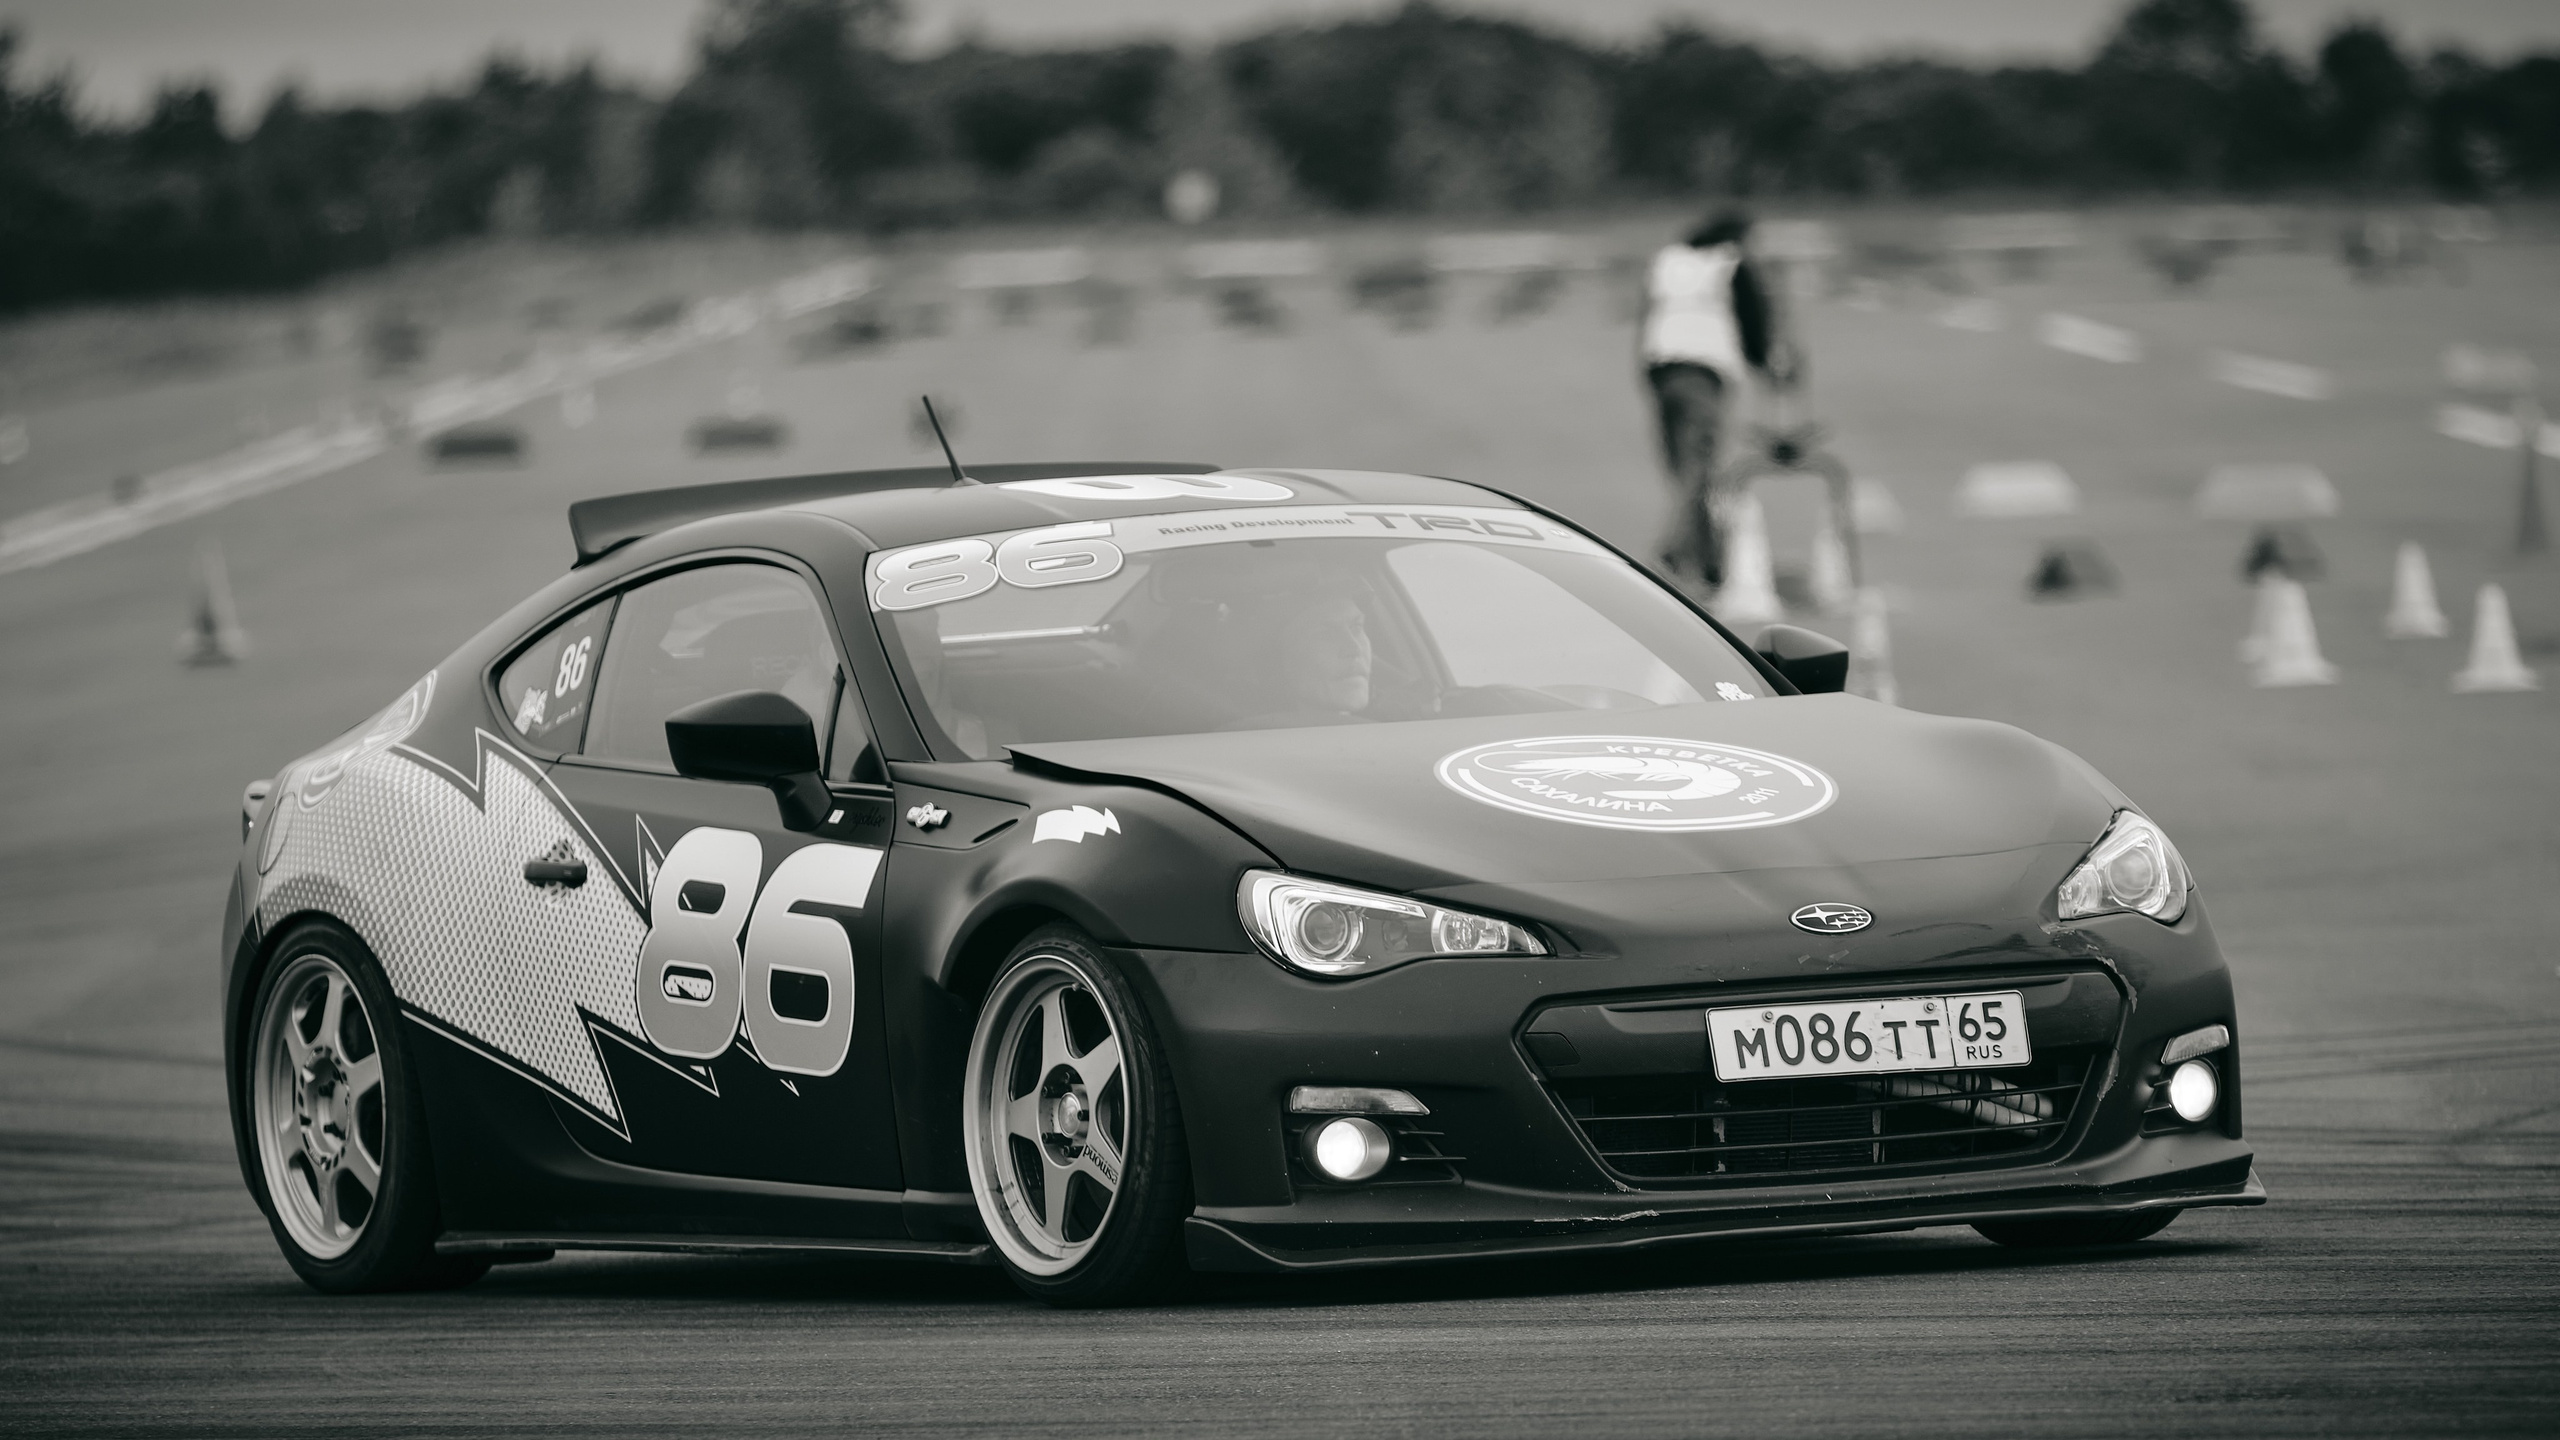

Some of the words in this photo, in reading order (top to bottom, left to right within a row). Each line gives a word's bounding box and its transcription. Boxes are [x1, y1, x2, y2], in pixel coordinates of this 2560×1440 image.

[1158, 522, 1228, 536] Racing
[1230, 517, 1356, 530] Development
[1345, 511, 1545, 541] TRD
[875, 521, 1125, 612] 86
[555, 635, 592, 698] 86
[1605, 745, 1774, 778] КРЕВЕТКА
[1511, 777, 1674, 813] САХАЛИНА
[1738, 787, 1780, 806] 2011
[635, 826, 885, 1078] 86
[1958, 1001, 2007, 1041] 65
[1966, 1044, 2003, 1060] RUS
